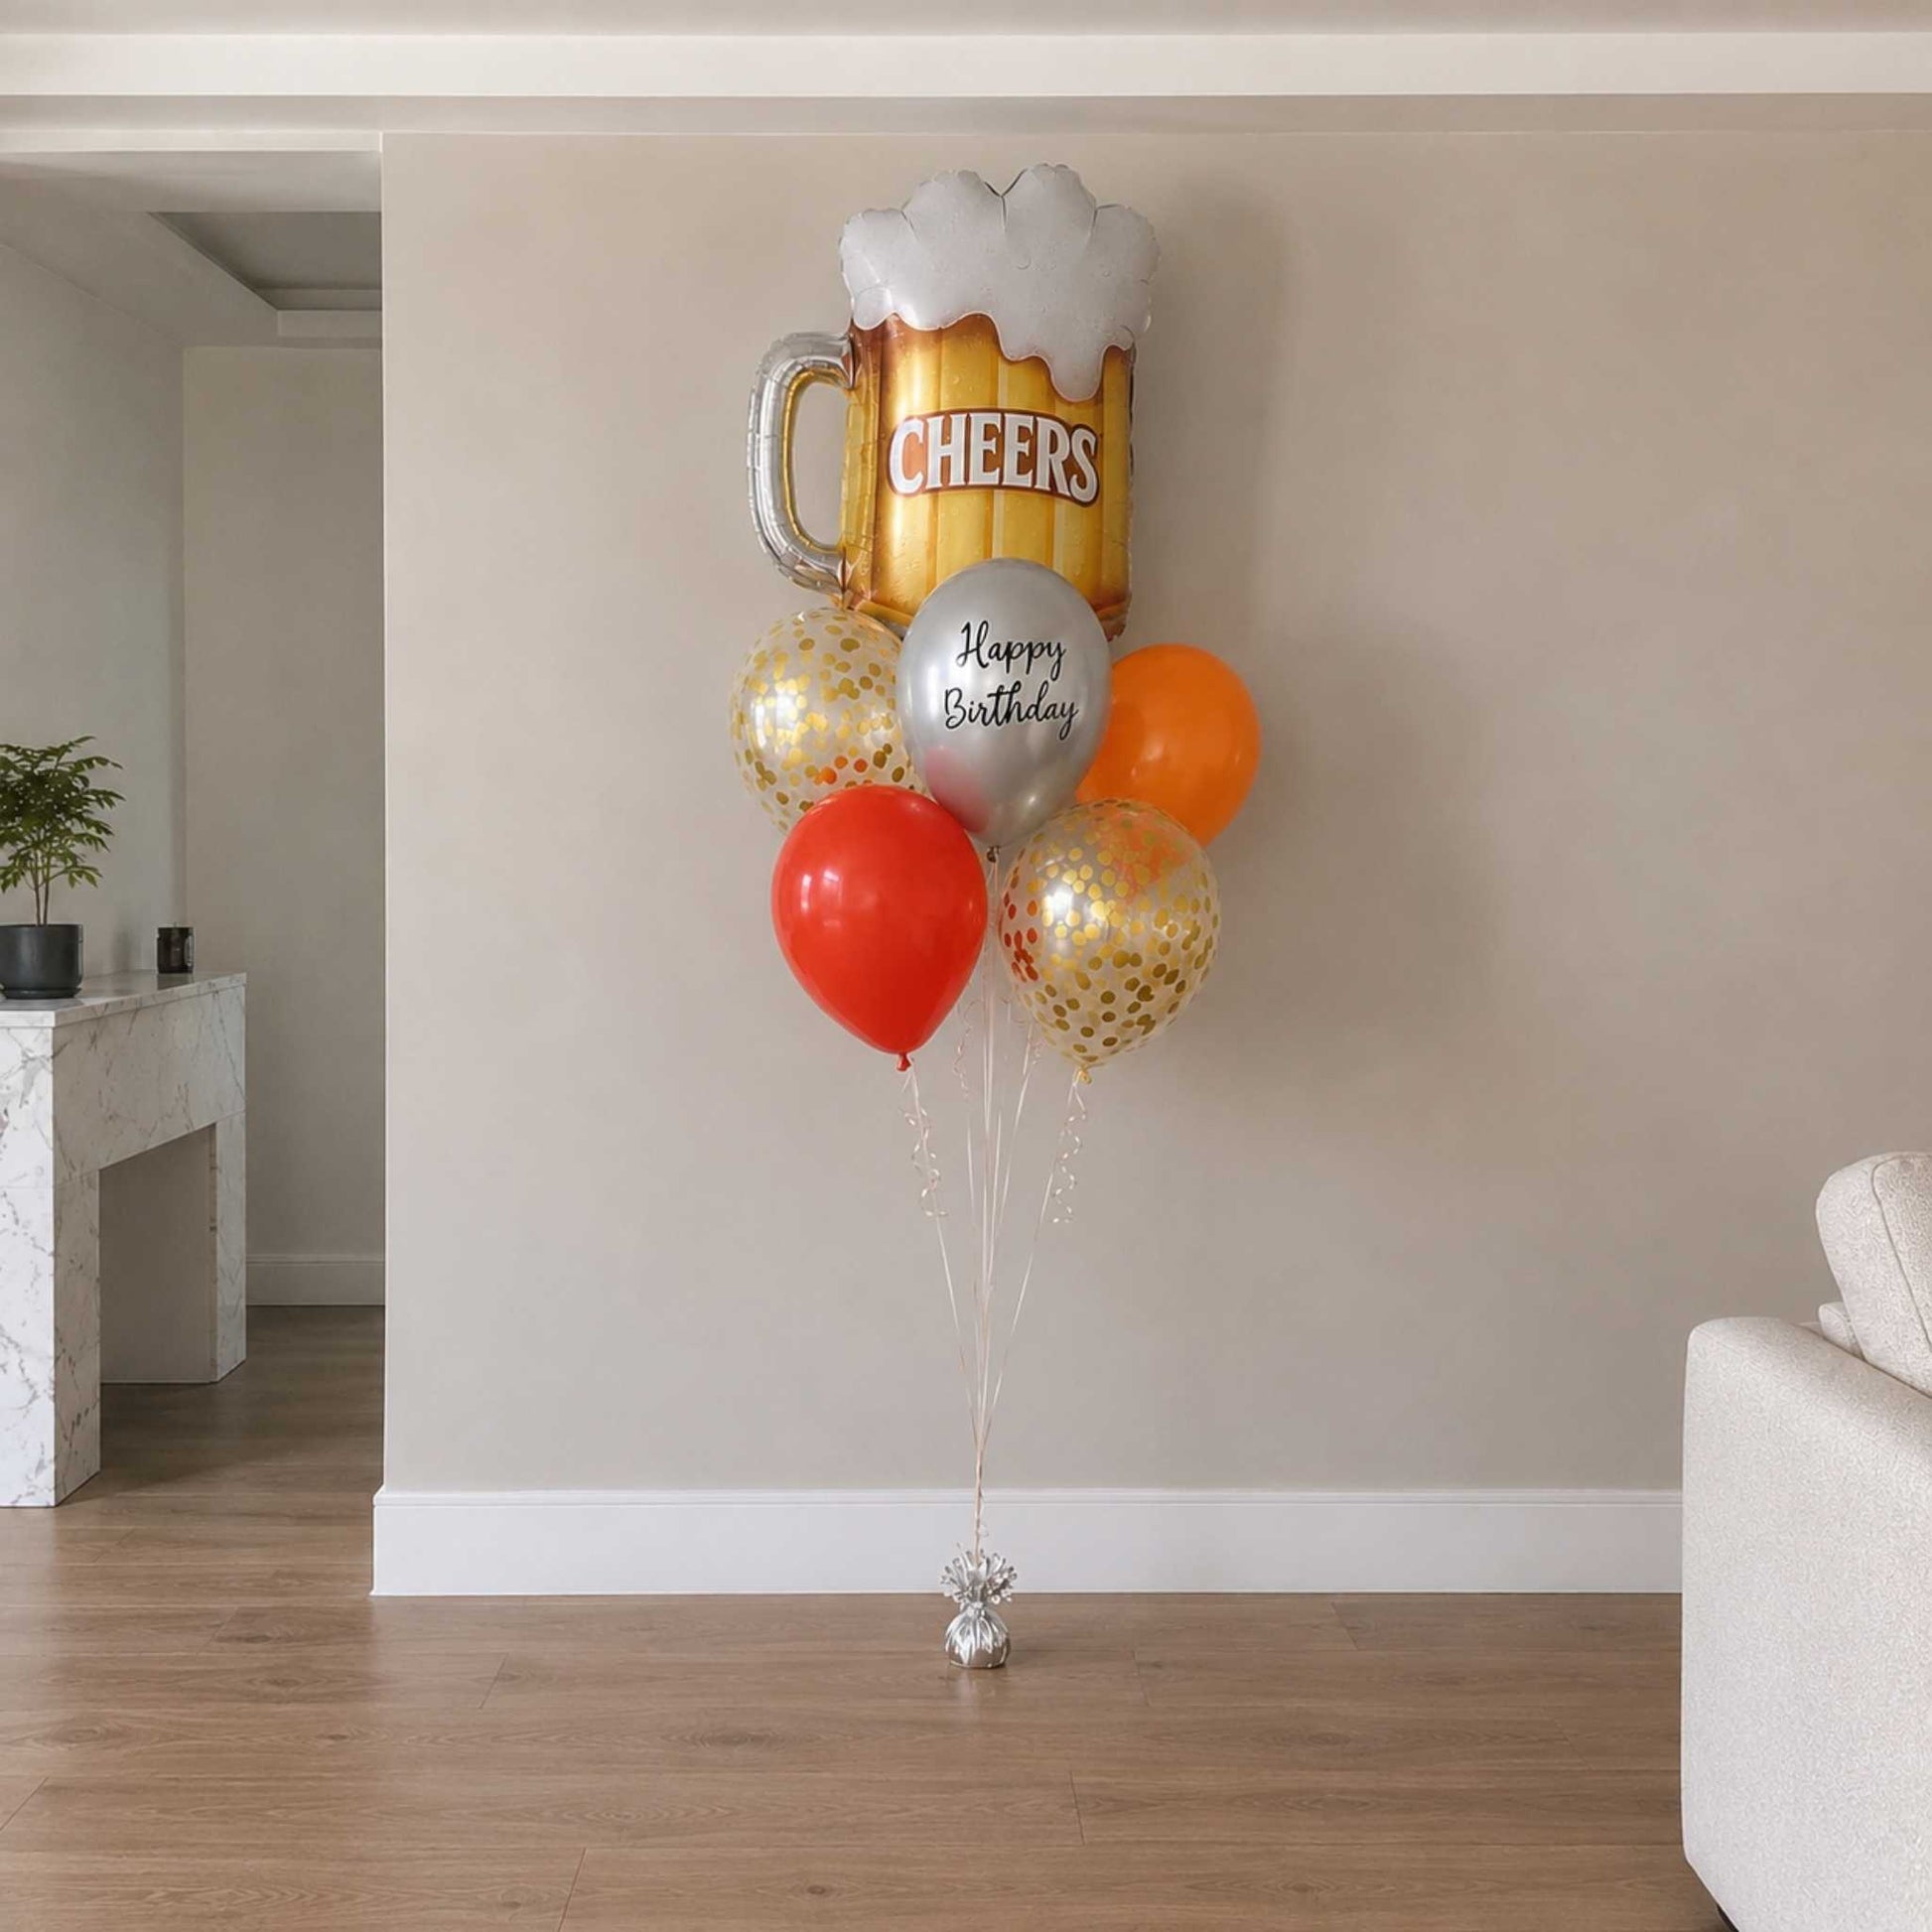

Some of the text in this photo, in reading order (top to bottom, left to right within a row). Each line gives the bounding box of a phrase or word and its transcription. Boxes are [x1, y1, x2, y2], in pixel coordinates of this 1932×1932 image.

[889, 412, 1098, 503] CHEERS
[956, 621, 1066, 681] Happy
[944, 680, 1079, 741] Birthday
